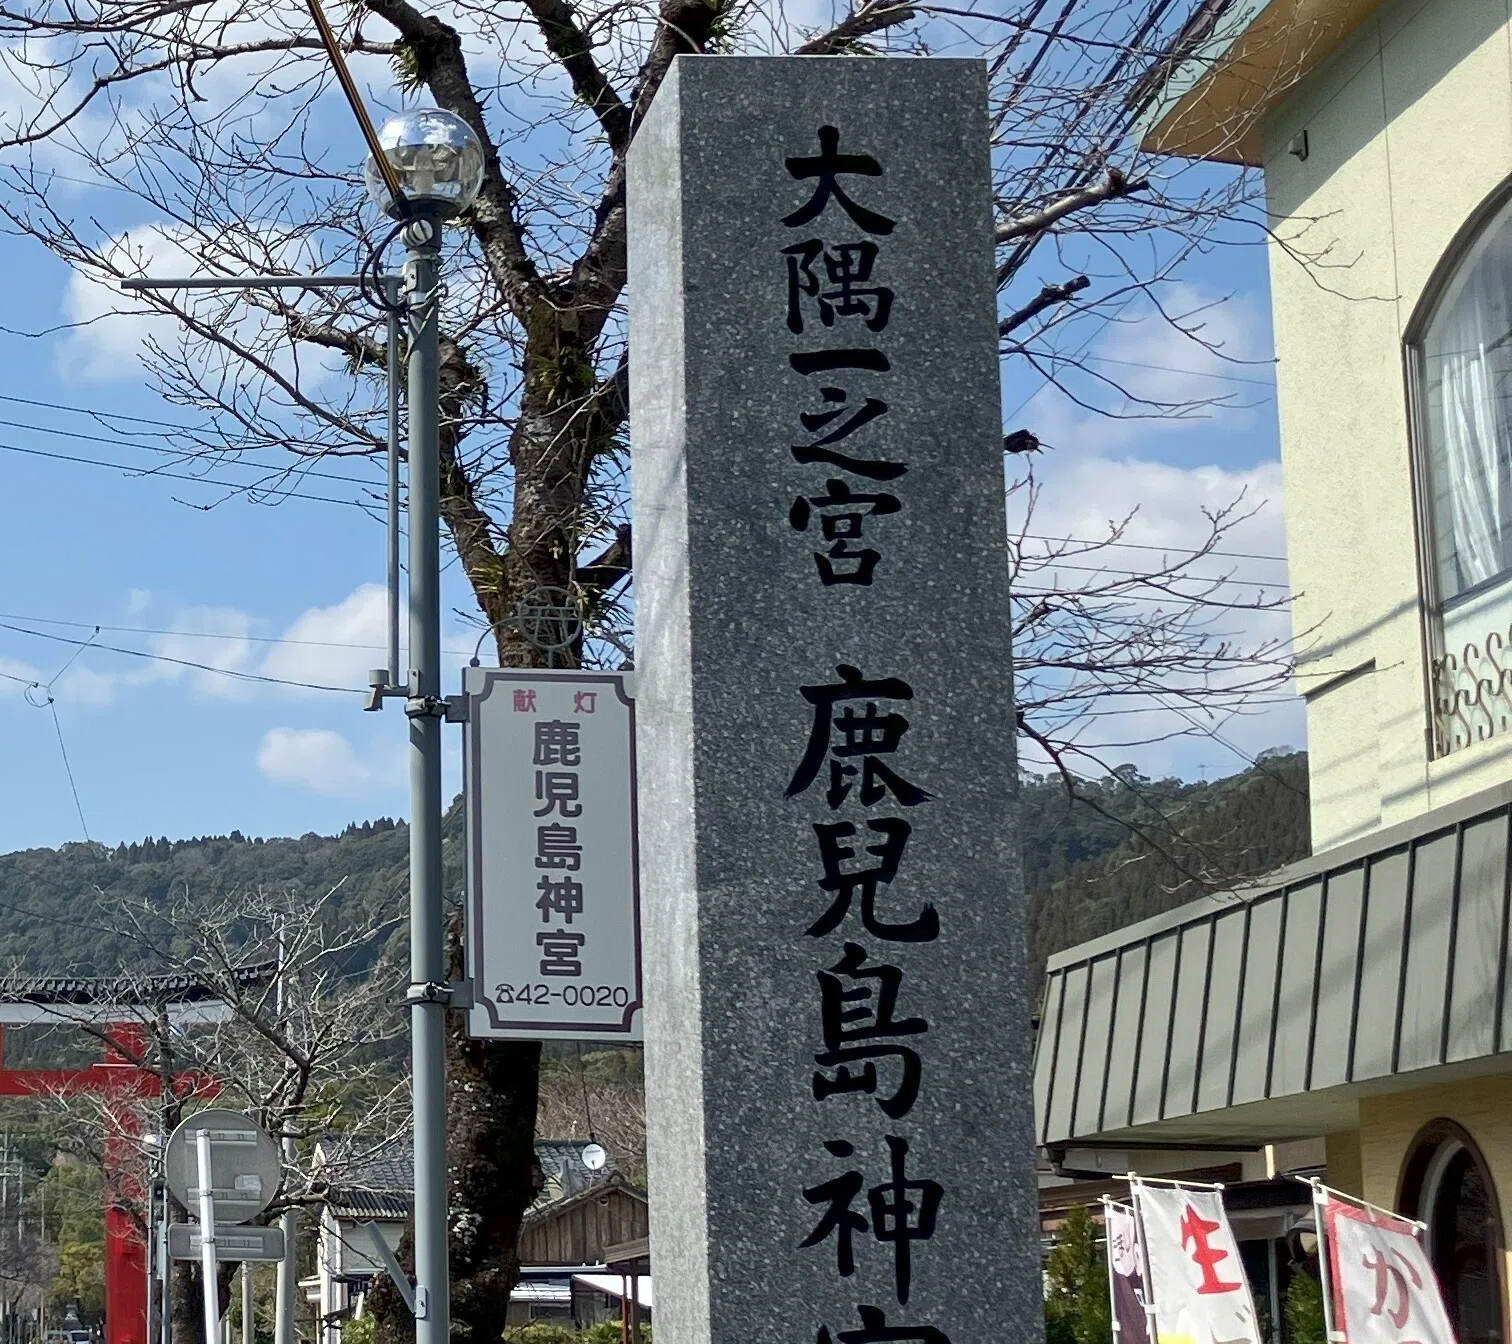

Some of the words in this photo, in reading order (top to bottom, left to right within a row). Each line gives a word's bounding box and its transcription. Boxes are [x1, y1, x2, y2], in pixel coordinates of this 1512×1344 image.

[780, 125, 908, 586] 大隅一之宮
[512, 689, 597, 714] 献灯
[531, 719, 586, 977] 鹿児島神宮
